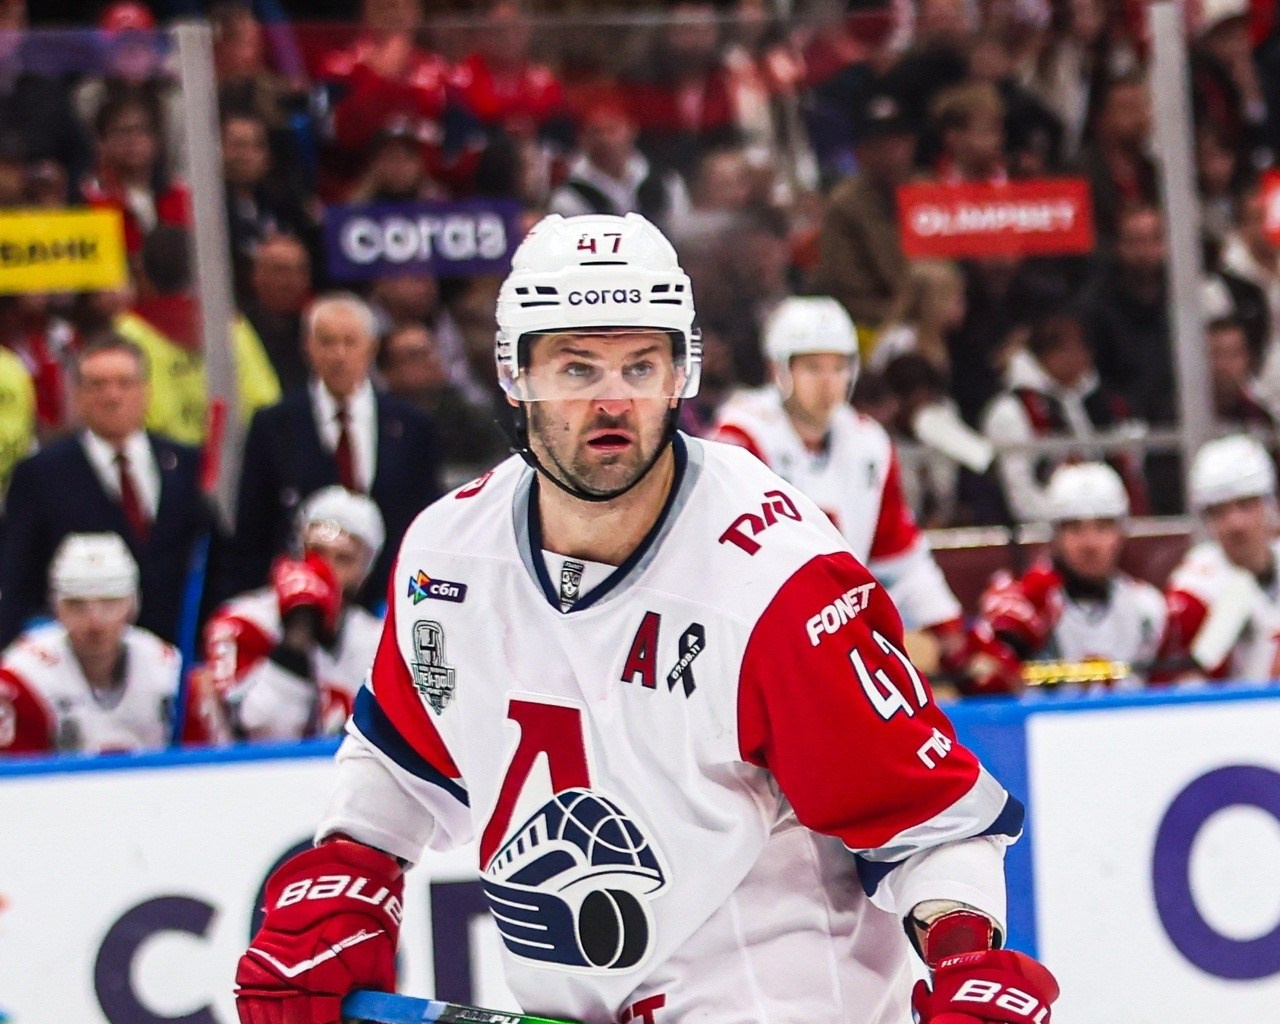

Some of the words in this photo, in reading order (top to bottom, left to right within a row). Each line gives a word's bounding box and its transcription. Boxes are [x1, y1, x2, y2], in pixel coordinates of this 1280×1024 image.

[577, 233, 622, 254] 47
[568, 289, 641, 306] согаз
[850, 629, 929, 721] 47
